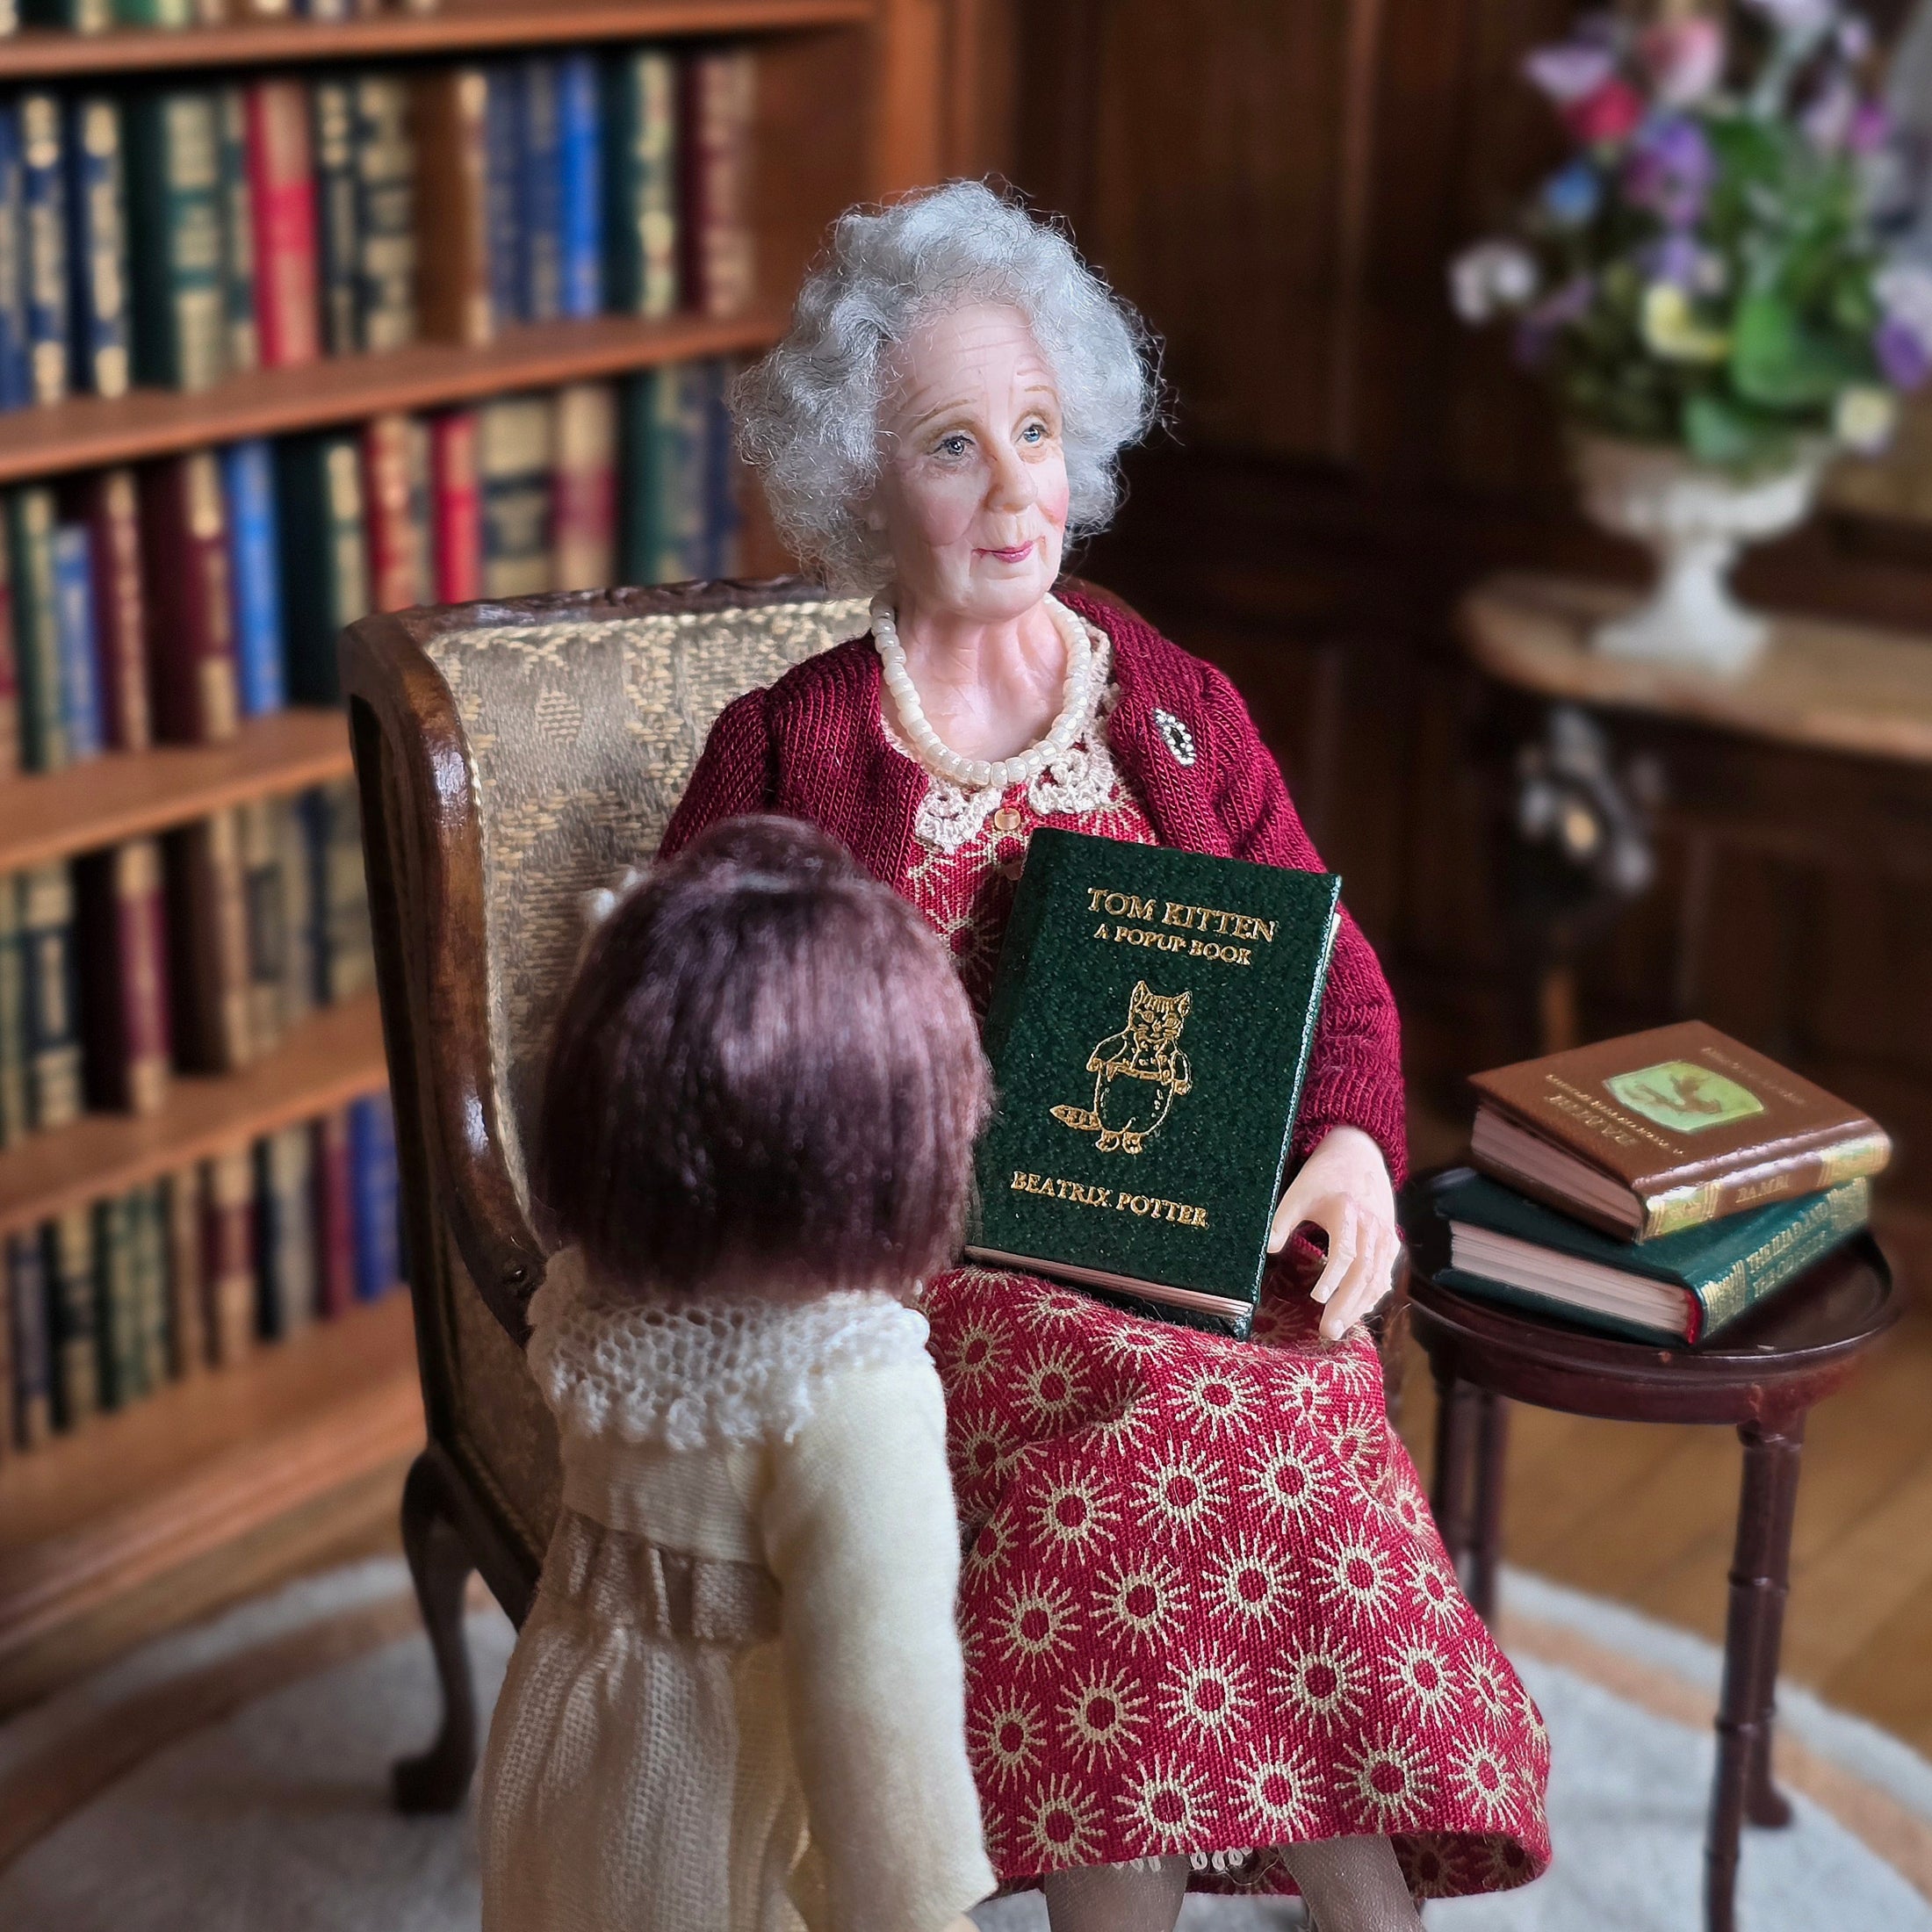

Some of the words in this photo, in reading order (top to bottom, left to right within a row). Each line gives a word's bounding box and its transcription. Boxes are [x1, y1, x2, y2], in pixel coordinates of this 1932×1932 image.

[1087, 887, 1157, 922] TOM
[1162, 901, 1278, 943] KITTEN
[1093, 923, 1109, 940] A
[1114, 926, 1186, 953] POPUP
[1188, 939, 1252, 966] BOOK
[1010, 1170, 1113, 1208] BEATRIX
[1115, 1192, 1210, 1229] POTTER
